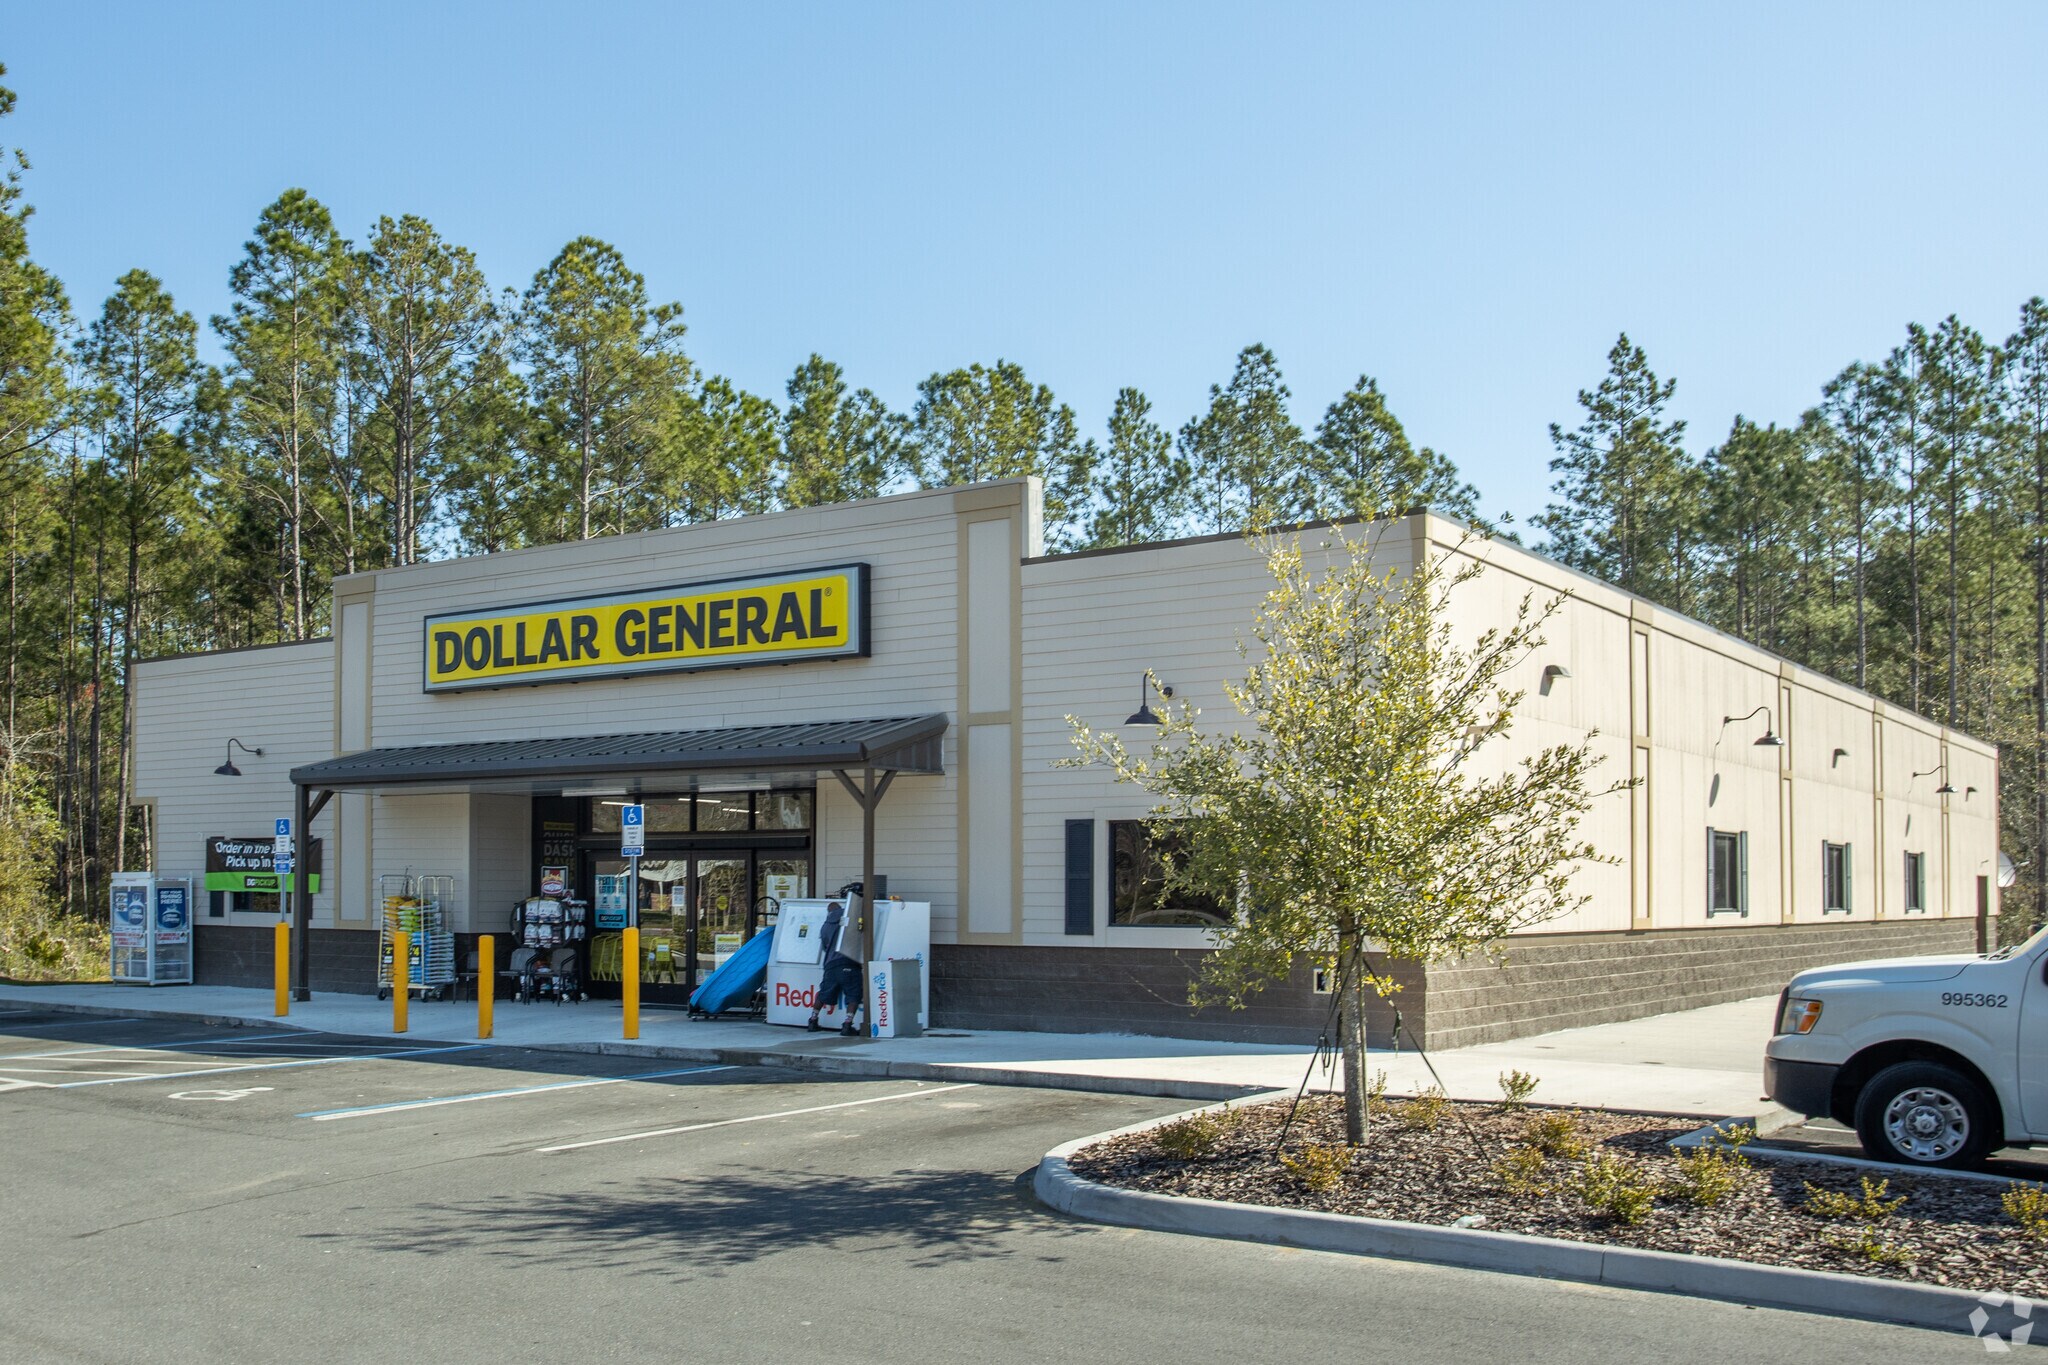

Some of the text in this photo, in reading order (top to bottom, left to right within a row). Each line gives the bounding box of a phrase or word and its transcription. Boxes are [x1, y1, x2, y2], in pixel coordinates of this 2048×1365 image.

[434, 588, 837, 675] DOLLAR GENERAL
[215, 841, 241, 853] Order
[243, 843, 253, 853] in
[254, 842, 270, 853] the
[225, 855, 246, 867] Pick
[247, 858, 260, 870] up
[261, 856, 271, 868] in
[1941, 992, 2008, 1008] 995362
